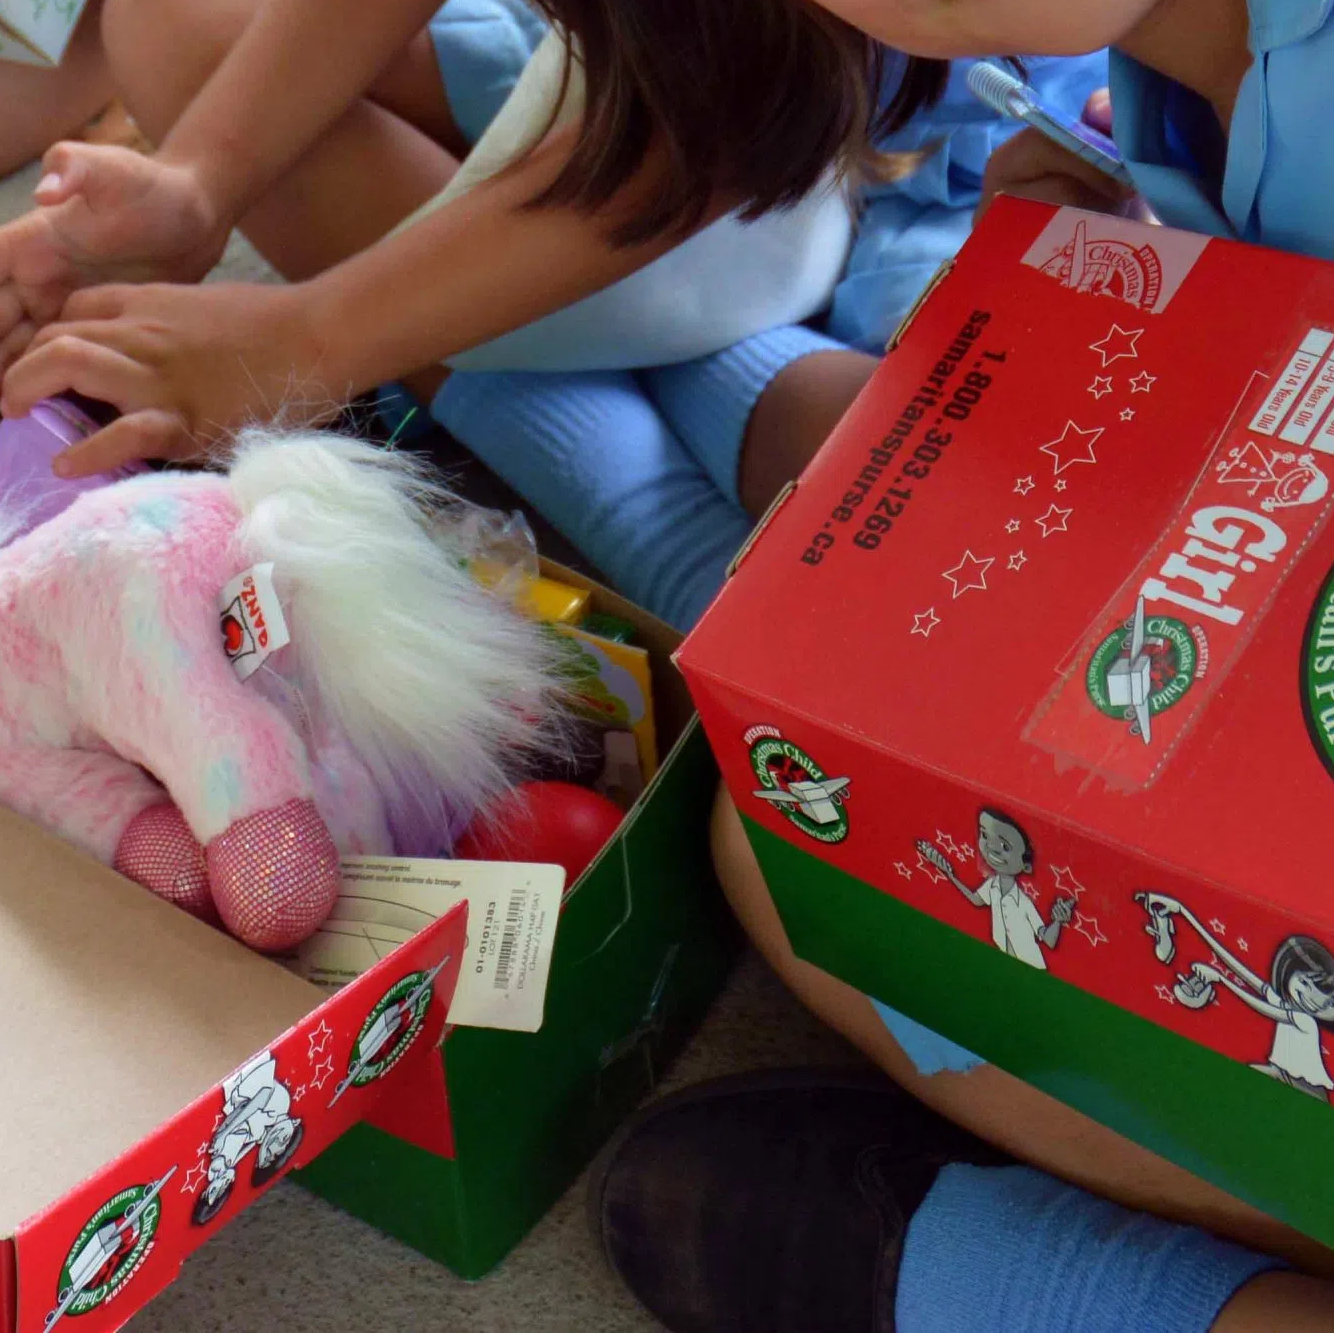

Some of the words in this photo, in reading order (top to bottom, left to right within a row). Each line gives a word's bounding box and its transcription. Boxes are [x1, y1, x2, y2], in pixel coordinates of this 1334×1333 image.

[1285, 358, 1311, 386] 10-14
[1268, 388, 1293, 413] Years
[1305, 384, 1330, 410] Years
[801, 309, 992, 566] samaritanspurse.ca
[1257, 413, 1276, 430] Old
[1294, 411, 1313, 427] Old
[853, 350, 1006, 551] 1.800.303.1269
[1139, 506, 1287, 626] Girl
[1147, 620, 1191, 670] Christmas
[1152, 673, 1190, 710] Child
[783, 744, 823, 780] Child
[475, 901, 496, 973] 01-0101383
[110, 1203, 158, 1286] Christmas
[105, 1240, 156, 1305] OPERATION
[71, 1284, 108, 1310] Child
